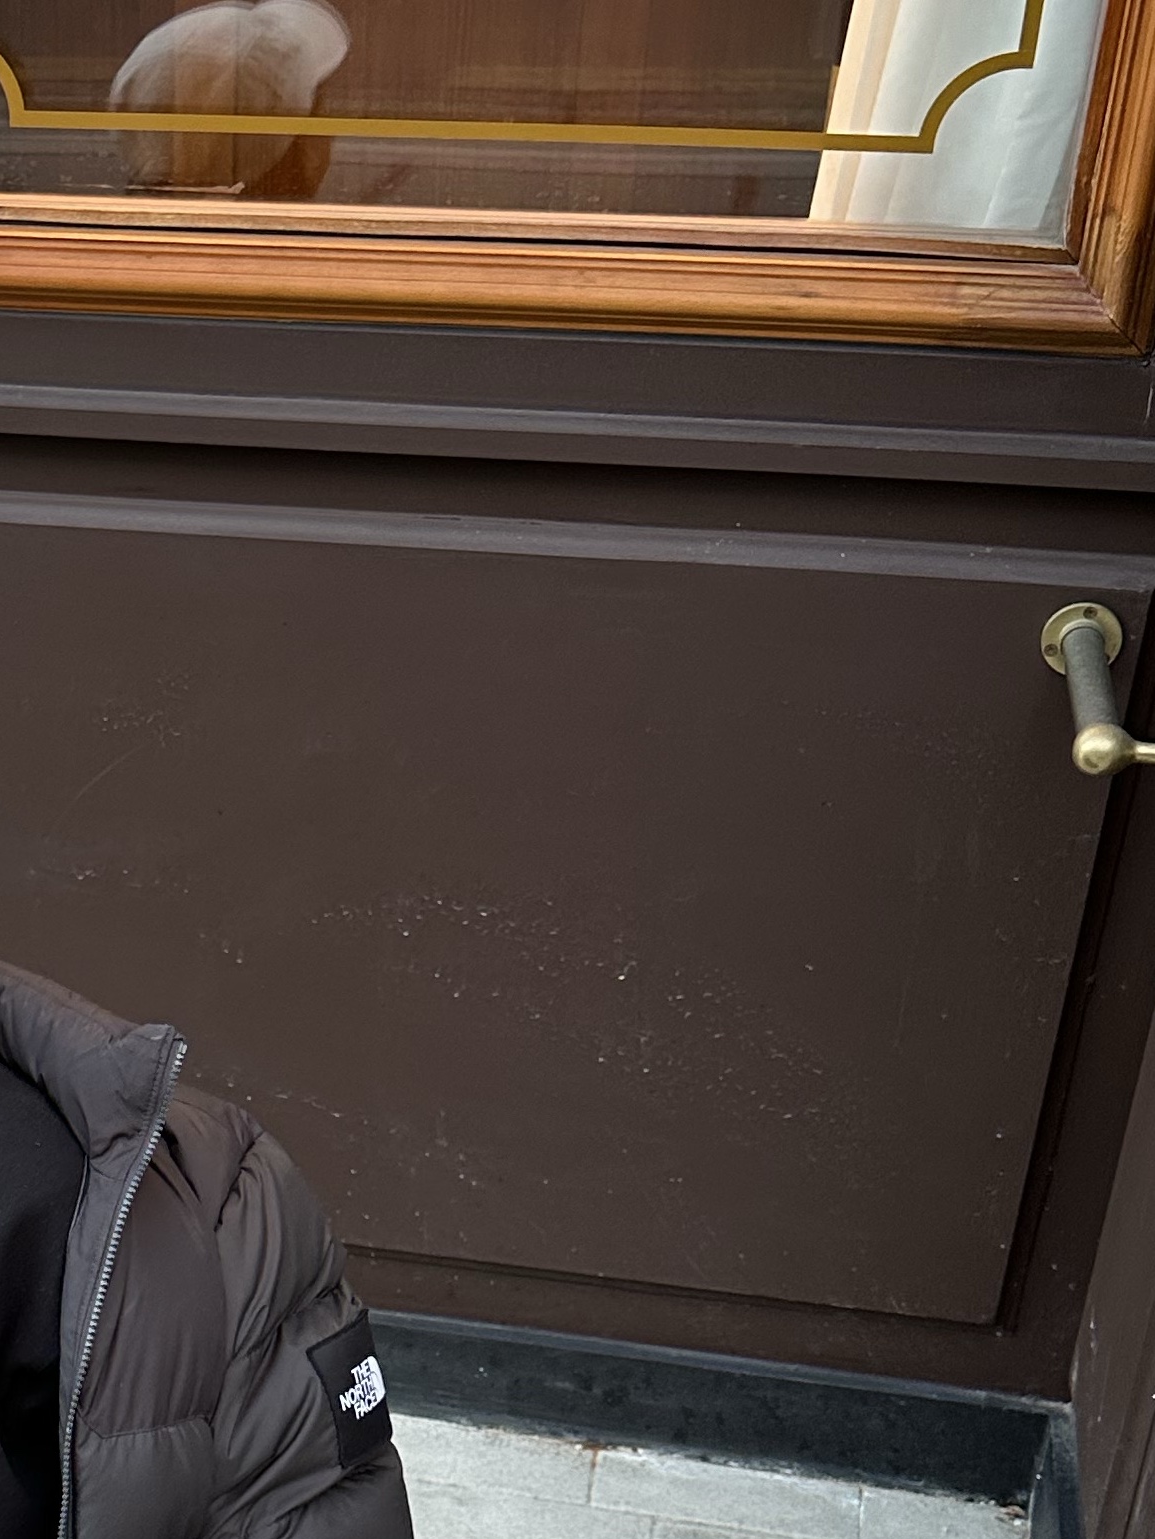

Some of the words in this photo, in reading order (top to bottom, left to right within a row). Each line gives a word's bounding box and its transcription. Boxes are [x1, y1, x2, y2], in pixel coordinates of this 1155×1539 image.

[351, 1359, 372, 1385] THE
[339, 1375, 376, 1411] NORTH
[354, 1390, 378, 1420] FACE
